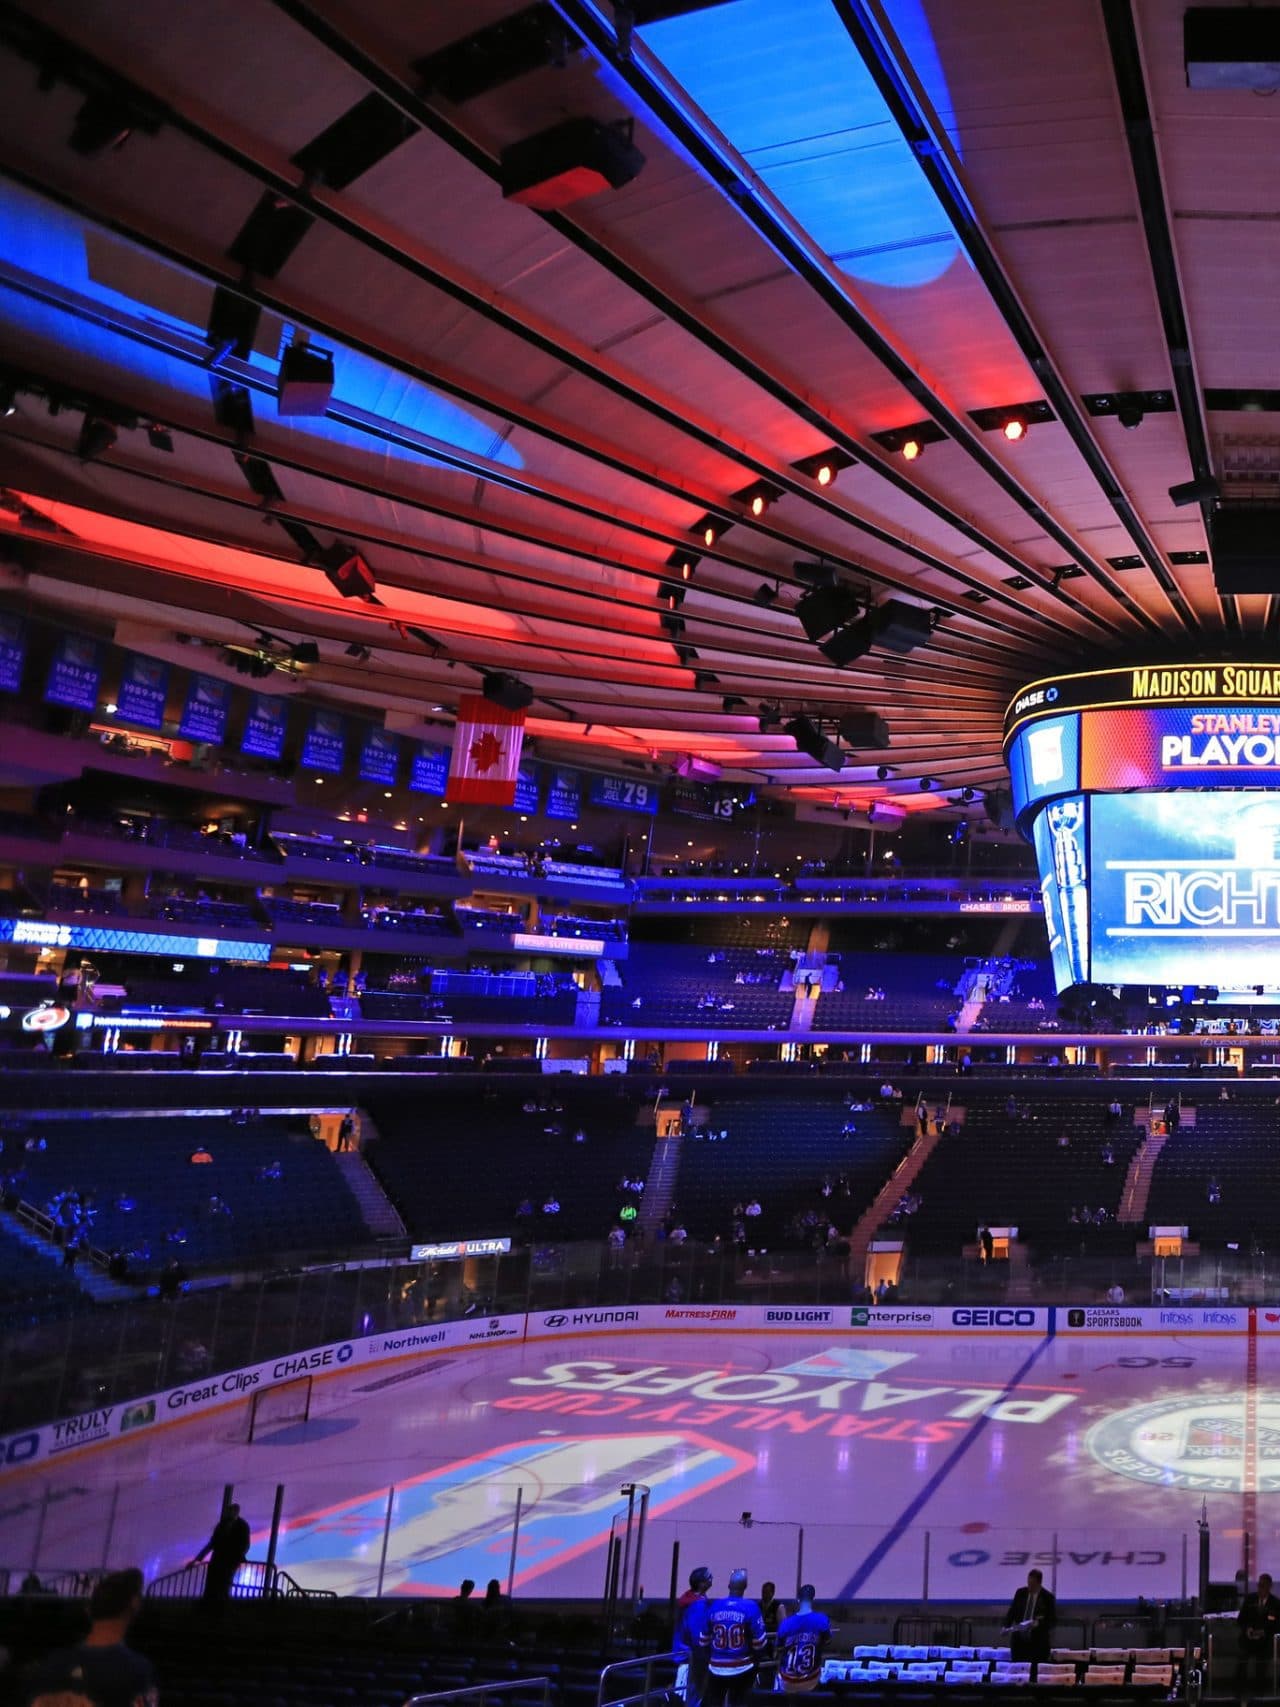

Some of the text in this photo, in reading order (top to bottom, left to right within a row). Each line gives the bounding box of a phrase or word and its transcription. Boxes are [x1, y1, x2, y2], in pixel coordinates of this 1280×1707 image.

[1132, 669, 1216, 698] MADISON
[1015, 690, 1045, 714] CHASE
[623, 782, 648, 805] 79
[960, 903, 991, 911] CHASE
[466, 1241, 504, 1253] ULTRA
[573, 1311, 639, 1325] HYUNDAI
[767, 1311, 831, 1321] BUD LIGHT
[856, 1310, 931, 1324] enterprise
[952, 1309, 1035, 1326] GEICO
[1086, 1317, 1142, 1327] SPORTSBOOK
[1160, 1311, 1193, 1325] Infosys
[1202, 1311, 1237, 1325] Infosys
[383, 1331, 447, 1351] Northwell
[273, 1350, 333, 1379] CHASE
[168, 1372, 260, 1409] Great Clips
[510, 1361, 1080, 1424] PLAYOFFS
[53, 1408, 114, 1440] TRULY
[491, 1391, 969, 1443] STANLEY CUP
[1104, 1449, 1233, 1489] RANGERS
[1001, 1551, 1166, 1567] CHASE
[712, 1623, 745, 1650] 30
[785, 1643, 816, 1675] 13
